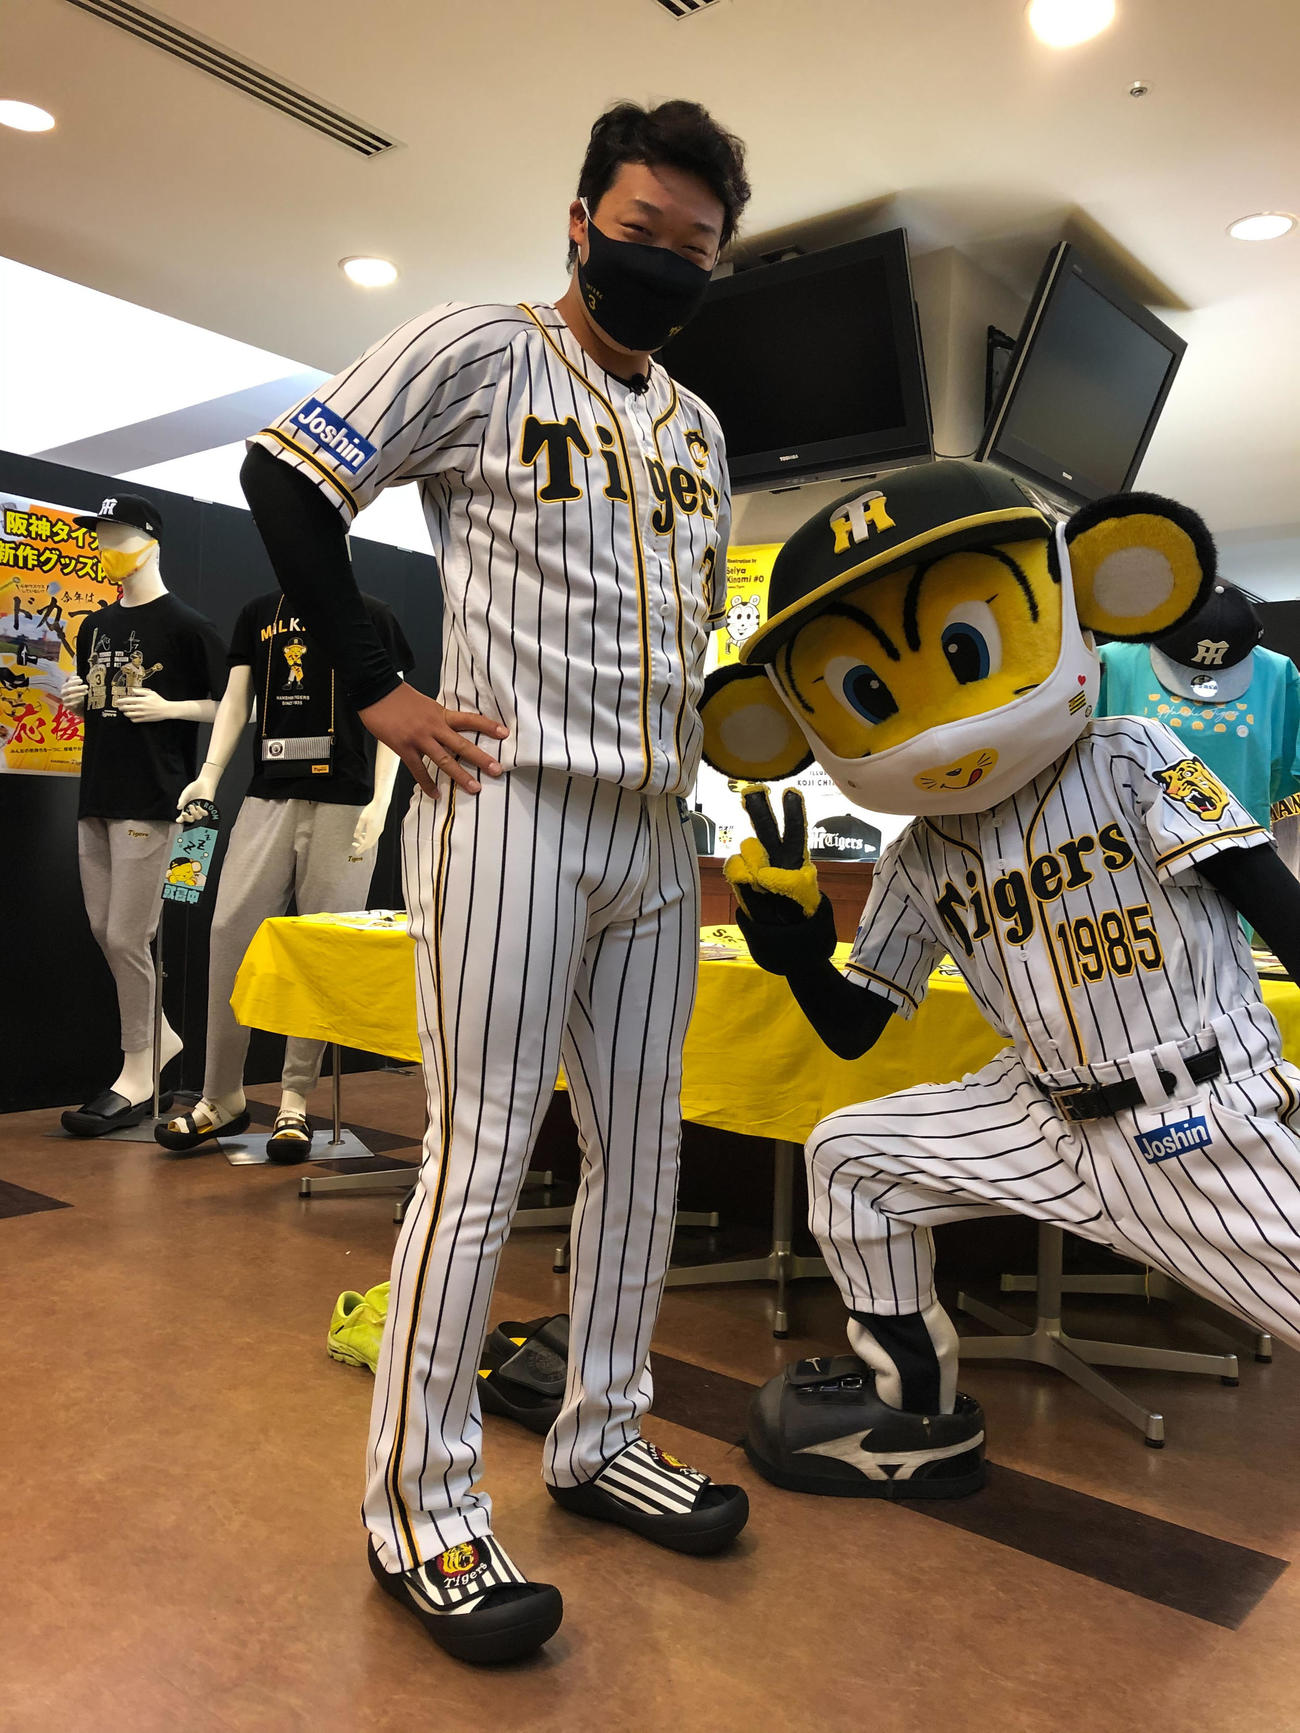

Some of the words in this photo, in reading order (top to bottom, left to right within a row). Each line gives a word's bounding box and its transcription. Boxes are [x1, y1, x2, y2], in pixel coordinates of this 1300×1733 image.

[297, 406, 365, 468] Joshin
[61, 590, 95, 603] 今年は
[95, 673, 102, 686] 3
[797, 779, 815, 787] KOJI
[824, 832, 864, 851] Tigers
[1056, 903, 1165, 988] 1985
[1142, 1123, 1209, 1161] Joshin
[443, 1562, 488, 1588] Tigers
